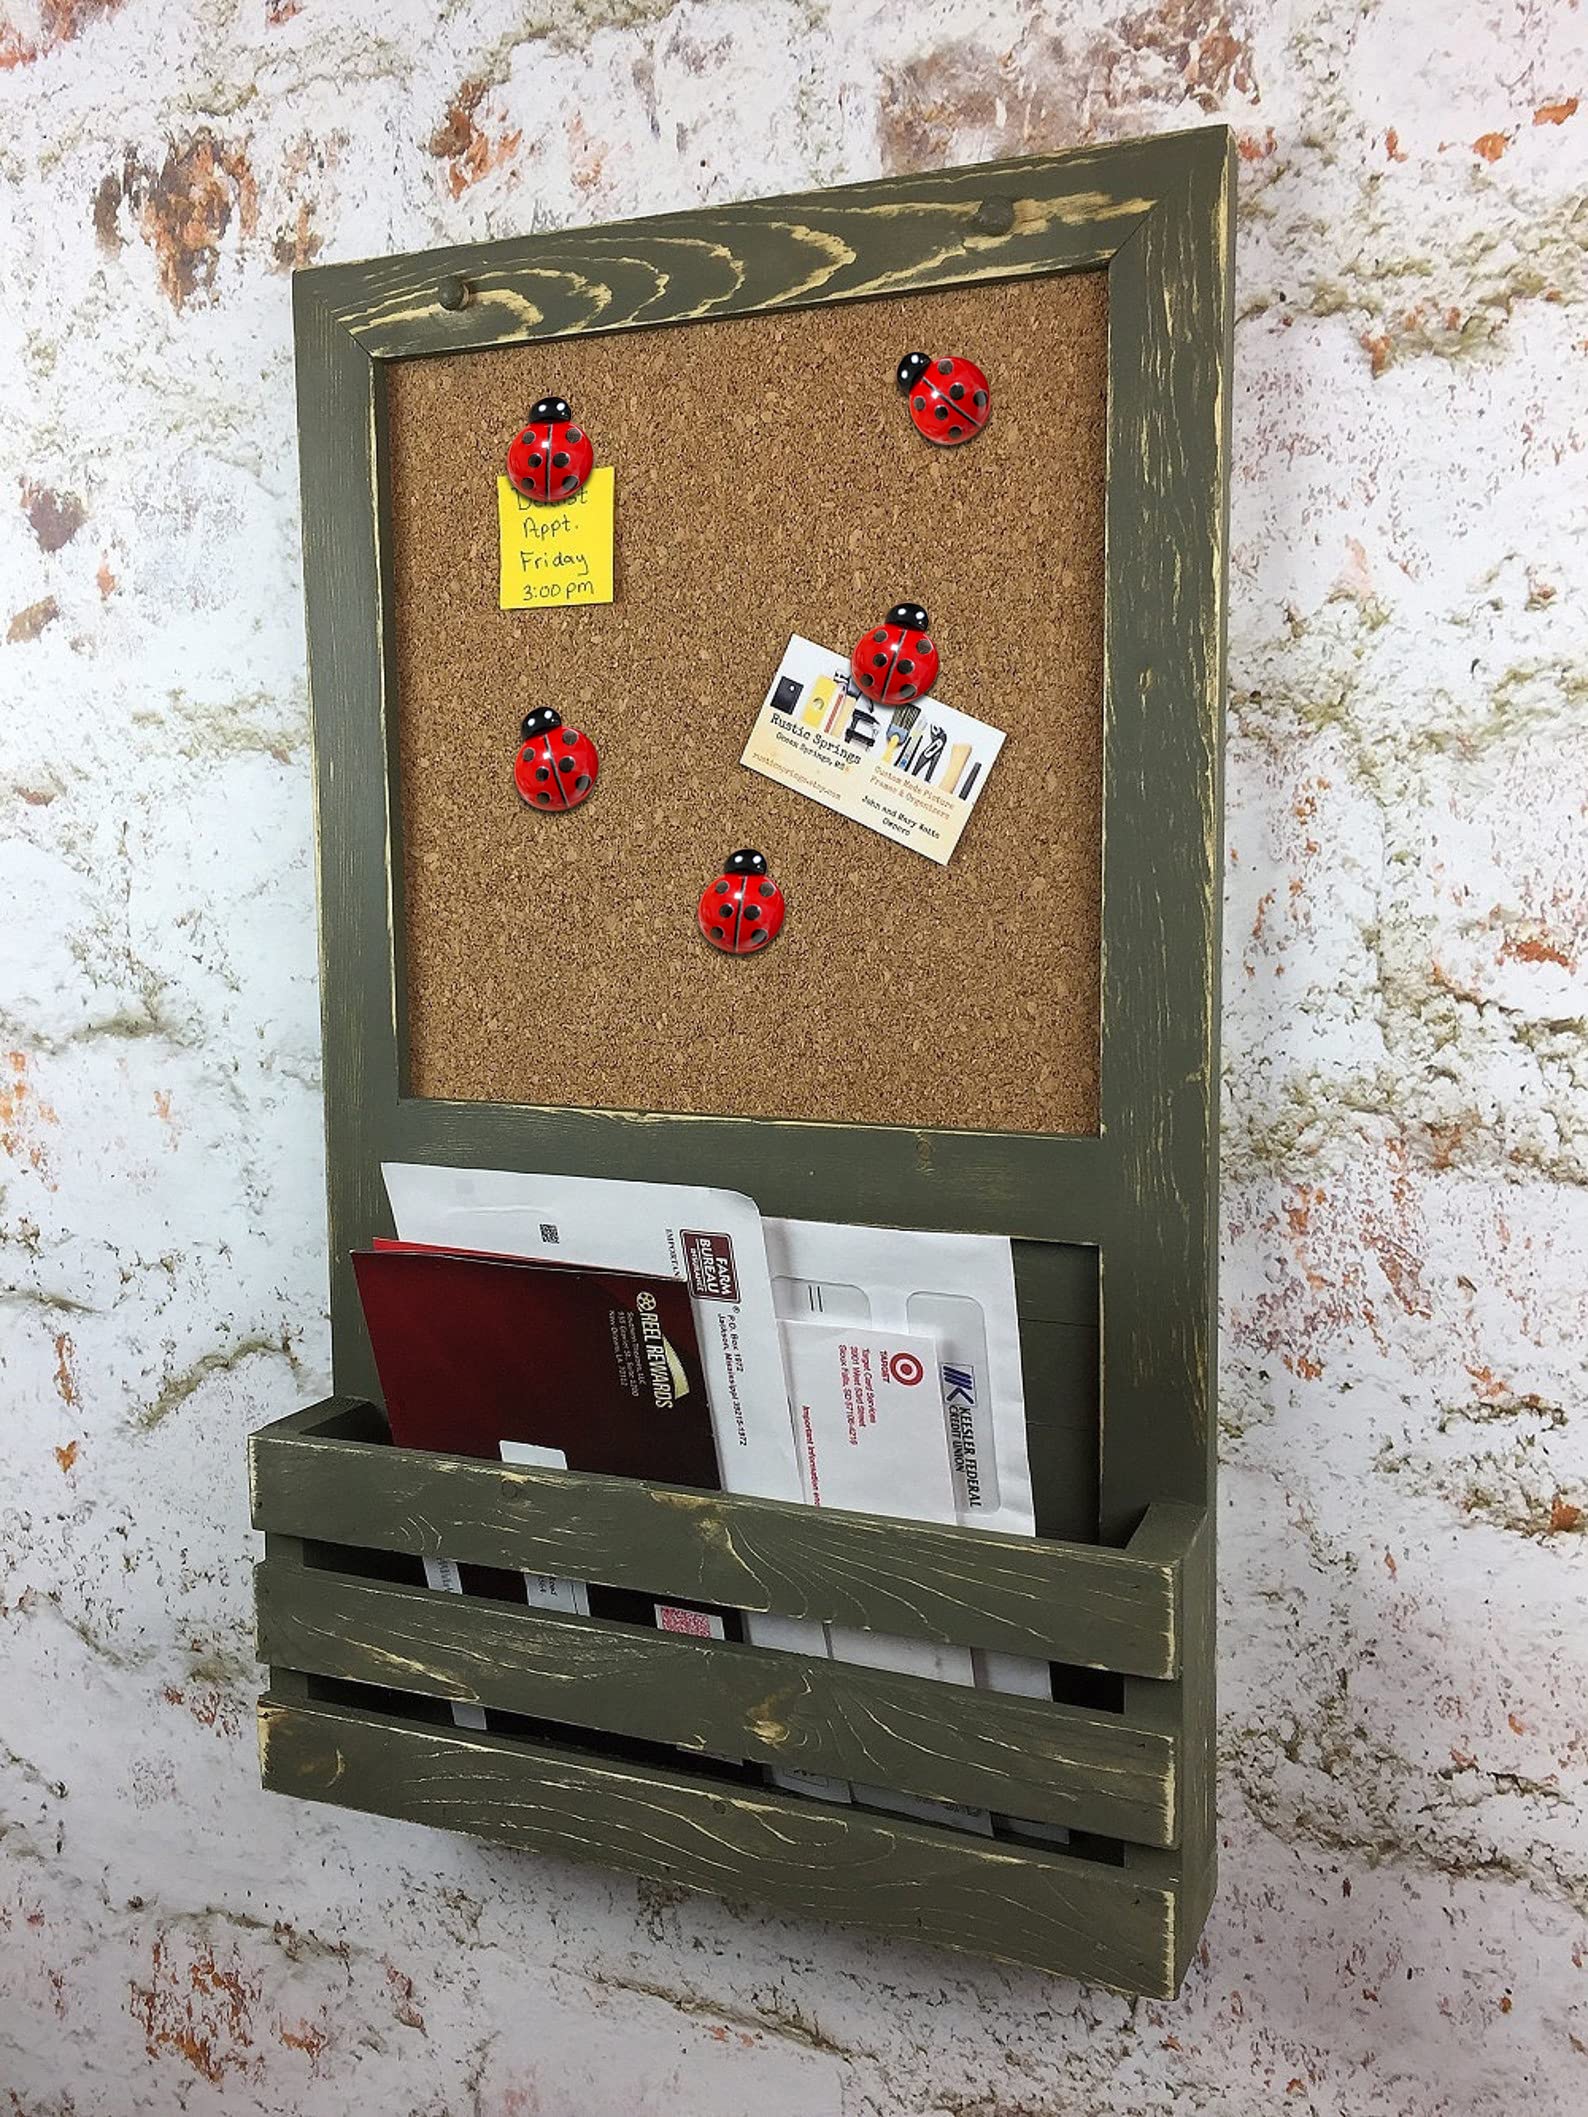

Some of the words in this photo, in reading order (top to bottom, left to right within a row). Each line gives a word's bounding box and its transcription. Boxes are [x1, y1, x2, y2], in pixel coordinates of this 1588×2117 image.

[523, 514, 579, 540] Appt.
[520, 550, 589, 576] Friday
[523, 584, 561, 601] 3:00
[566, 581, 594, 599] pm
[769, 713, 812, 740] Rustic
[810, 733, 863, 766] Springs
[699, 1239, 719, 1292] BUREAU
[715, 1257, 731, 1293] FARM
[639, 1311, 661, 1340] REEL
[645, 1344, 673, 1409] REWARDS
[948, 1406, 960, 1437] CREDIT
[959, 1408, 975, 1454] KEESLER
[952, 1441, 965, 1472] UNION
[964, 1458, 981, 1505] FEDERAL
